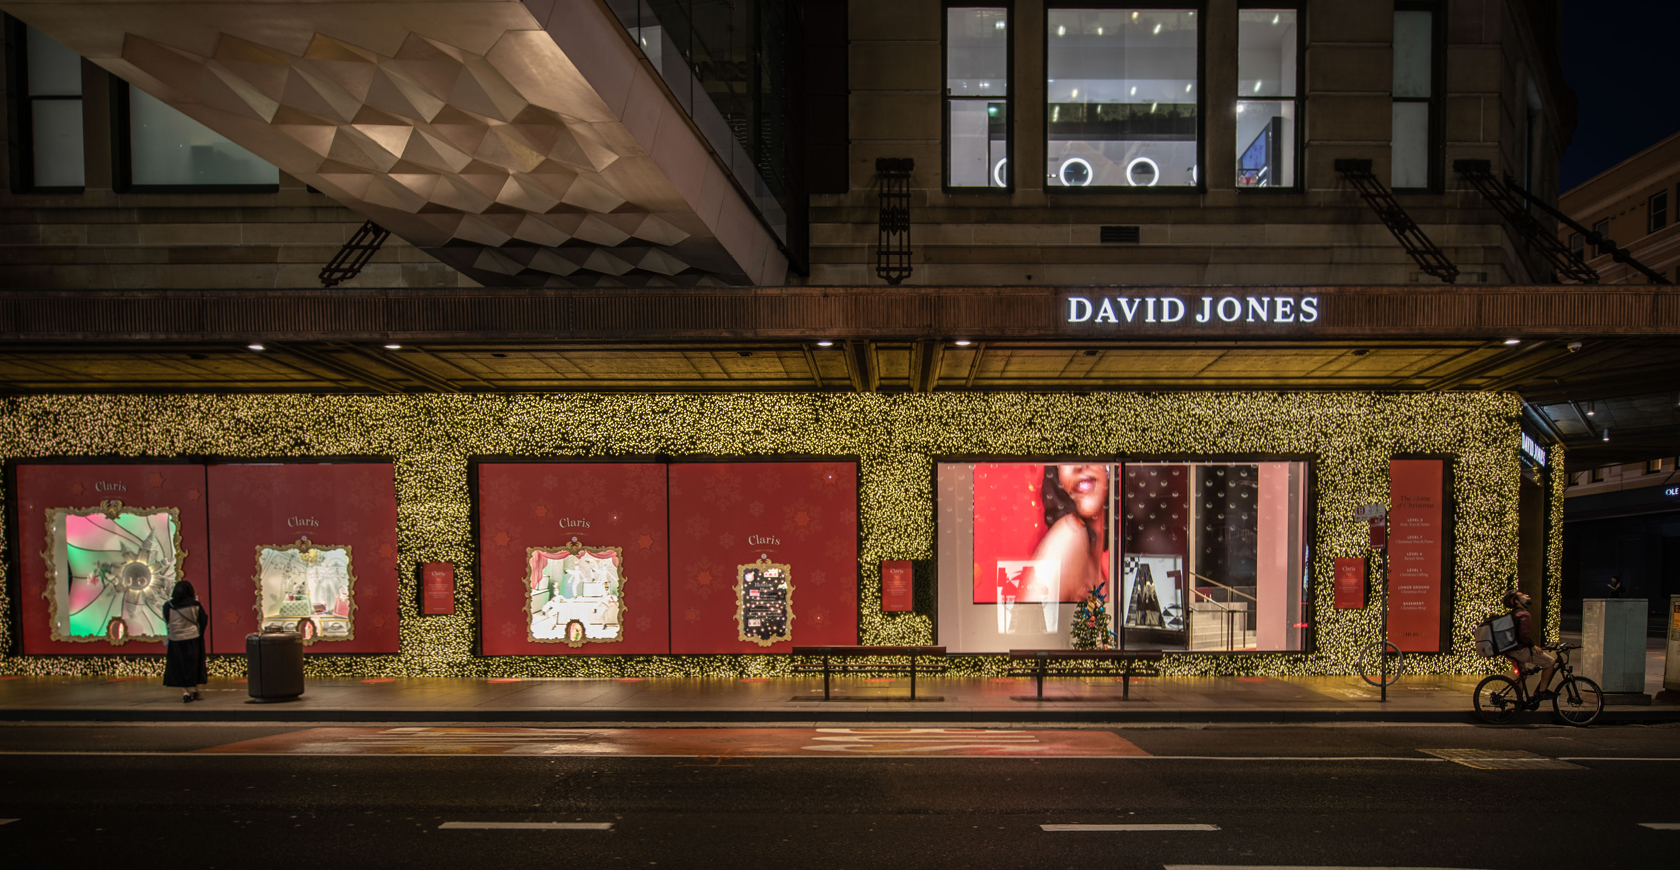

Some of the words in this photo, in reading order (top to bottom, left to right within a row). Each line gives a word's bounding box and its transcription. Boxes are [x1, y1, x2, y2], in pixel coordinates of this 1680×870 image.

[1067, 297, 1185, 323] DAVID
[1195, 297, 1319, 323] JONES
[95, 480, 128, 492] Claris
[1665, 487, 1680, 496] OLE
[287, 516, 320, 528] Claris
[558, 517, 591, 529] Claris
[748, 534, 781, 546] Claris
